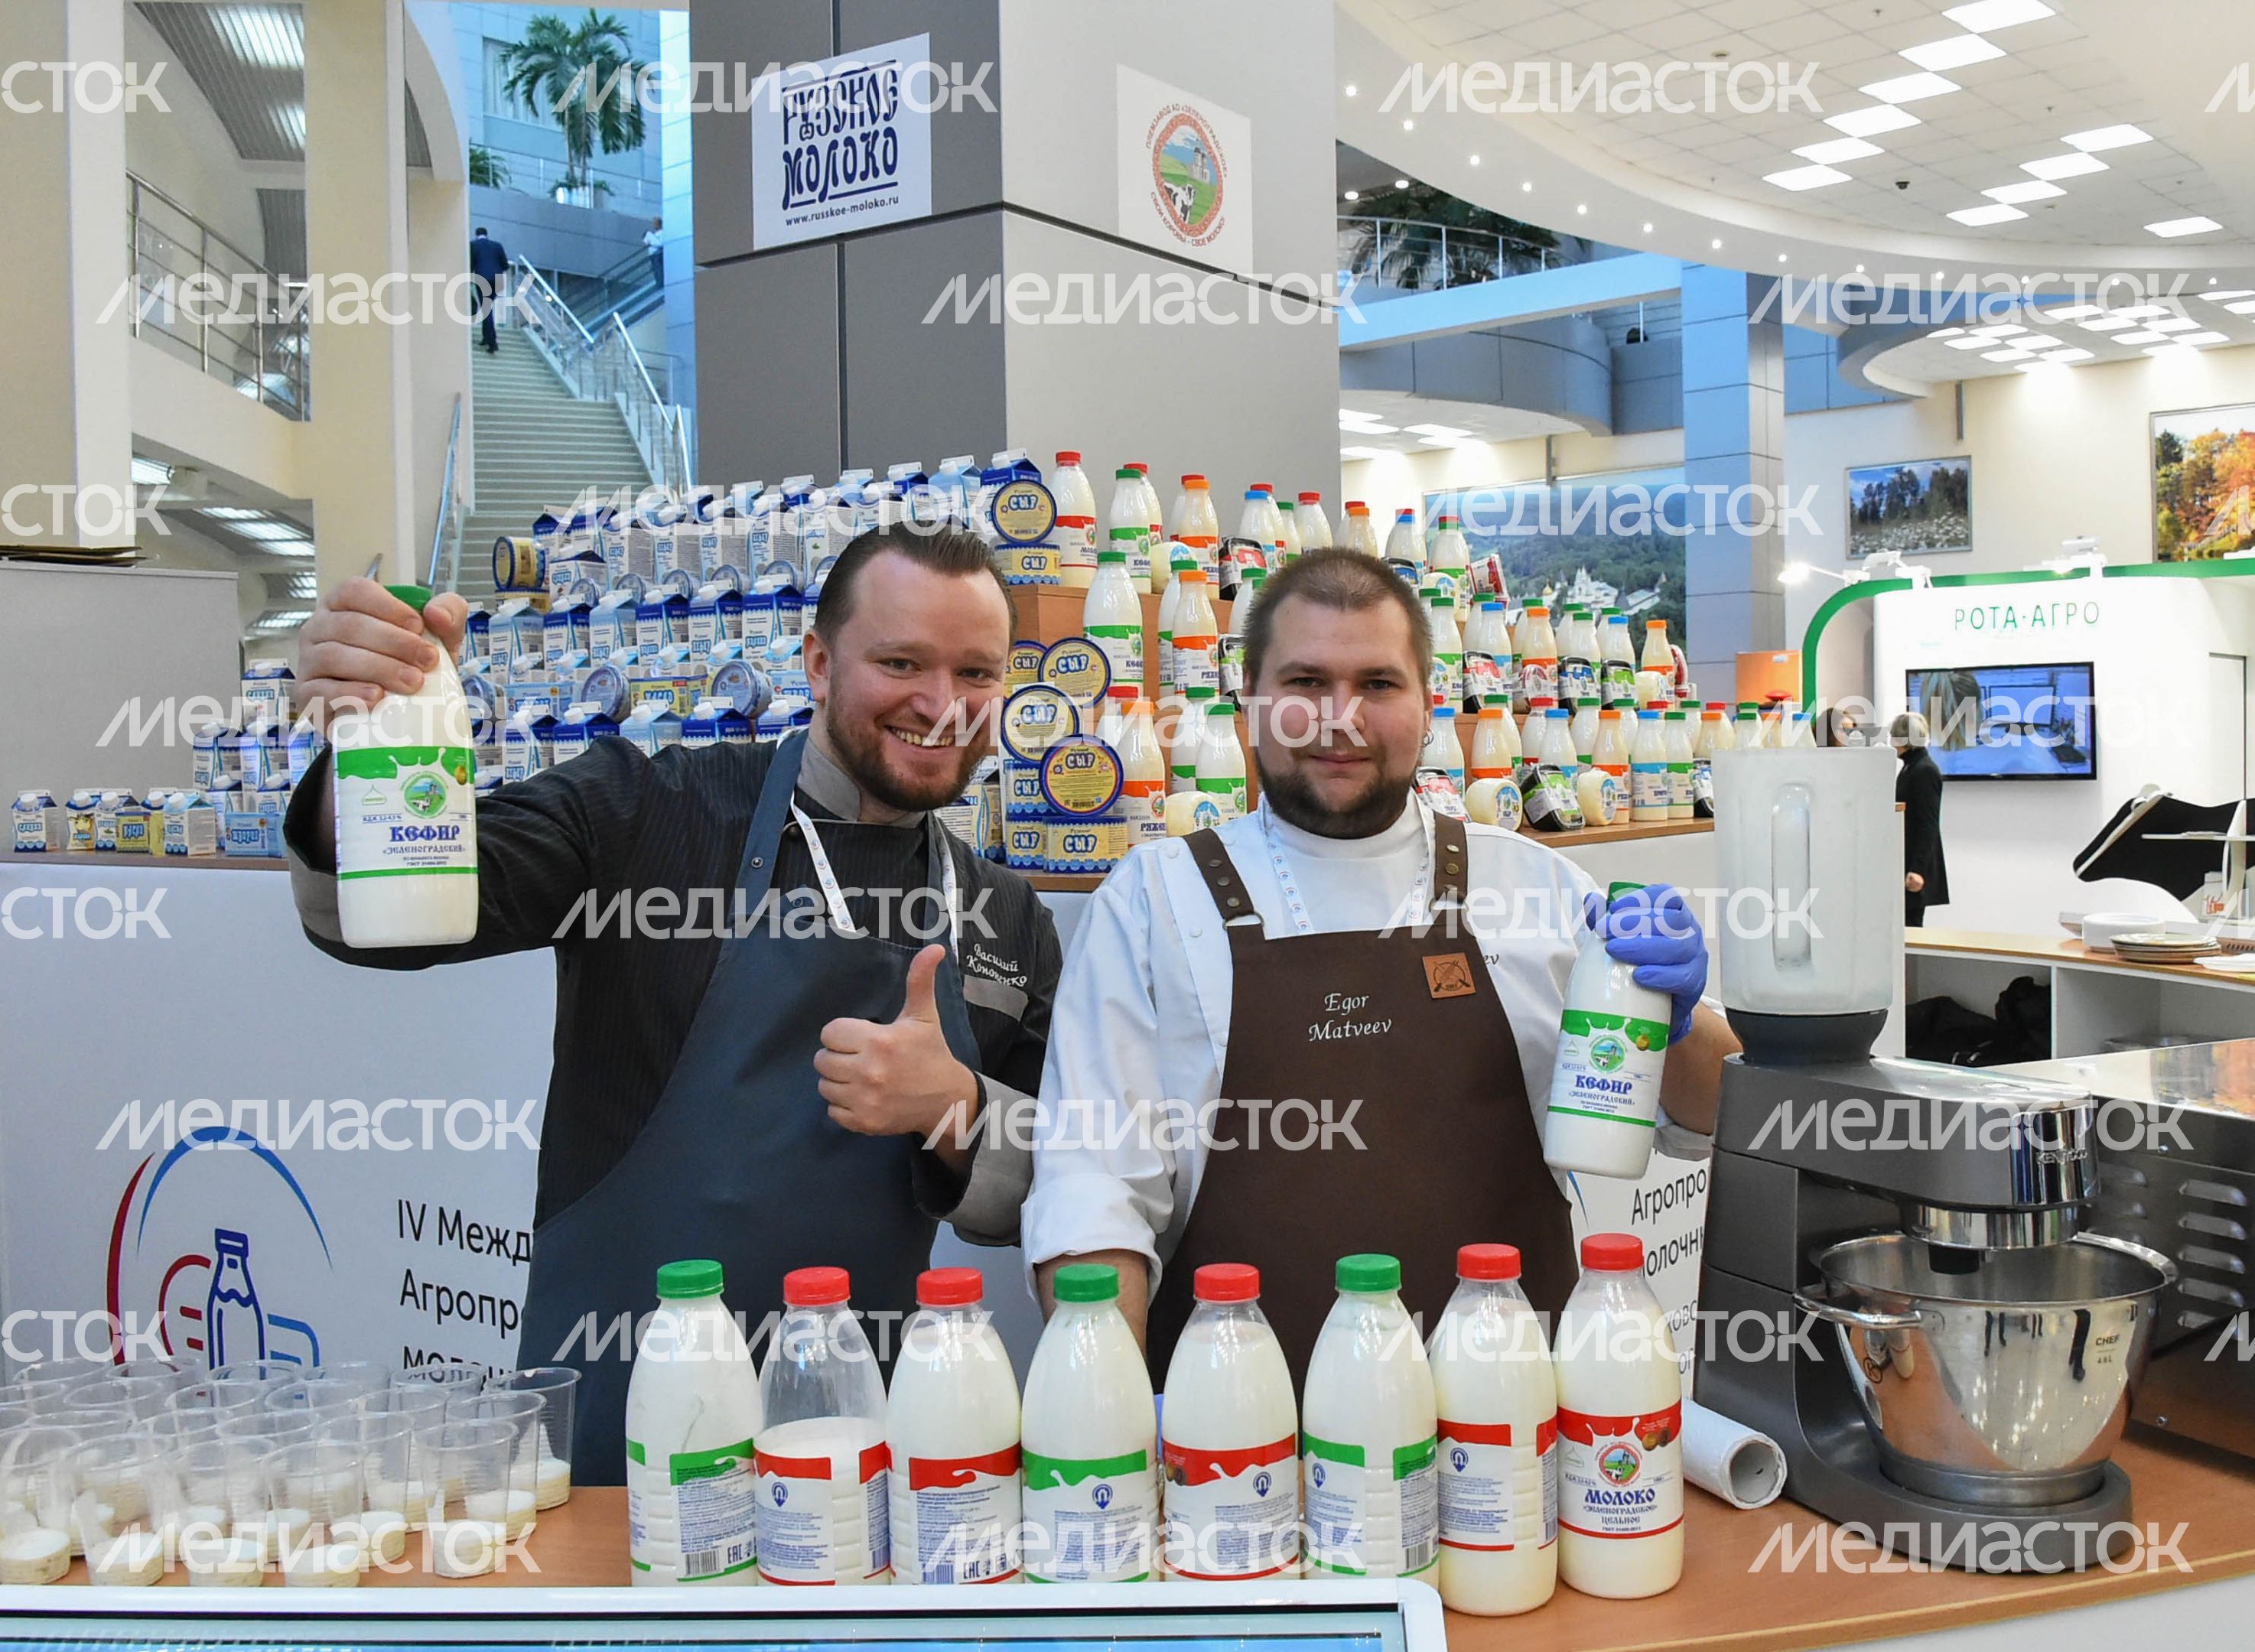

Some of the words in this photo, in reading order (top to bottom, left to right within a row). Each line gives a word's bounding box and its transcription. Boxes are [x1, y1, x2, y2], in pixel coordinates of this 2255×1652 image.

[783, 127, 898, 210] МОЛОКО
[786, 196, 899, 226] www.russkoe-moloko.ru
[1008, 494, 1038, 510] СЫР
[1022, 556, 1047, 570] СЫР
[1014, 656, 1039, 669] СЫР
[1056, 655, 1089, 674] СЫР
[1020, 704, 1057, 724] СЫР
[1066, 753, 1096, 769] СЫР
[1014, 779, 1040, 796] СЫР
[389, 824, 460, 842] КЕФИР
[1012, 831, 1040, 849] СЫР
[1063, 835, 1097, 853] СЫР
[1324, 993, 1369, 1016] Egor
[1309, 1019, 1392, 1042] Matveev
[1576, 1075, 1632, 1094] КЕФИР
[1632, 1169, 1707, 1224] Агропро
[398, 1199, 427, 1242] IV
[400, 1269, 525, 1338] Агропр
[2096, 1334, 2120, 1345] CHEF
[1585, 1488, 1656, 1505] МОЛОКО
[1602, 1516, 1640, 1525] ЦЕЛЬНОЕ
